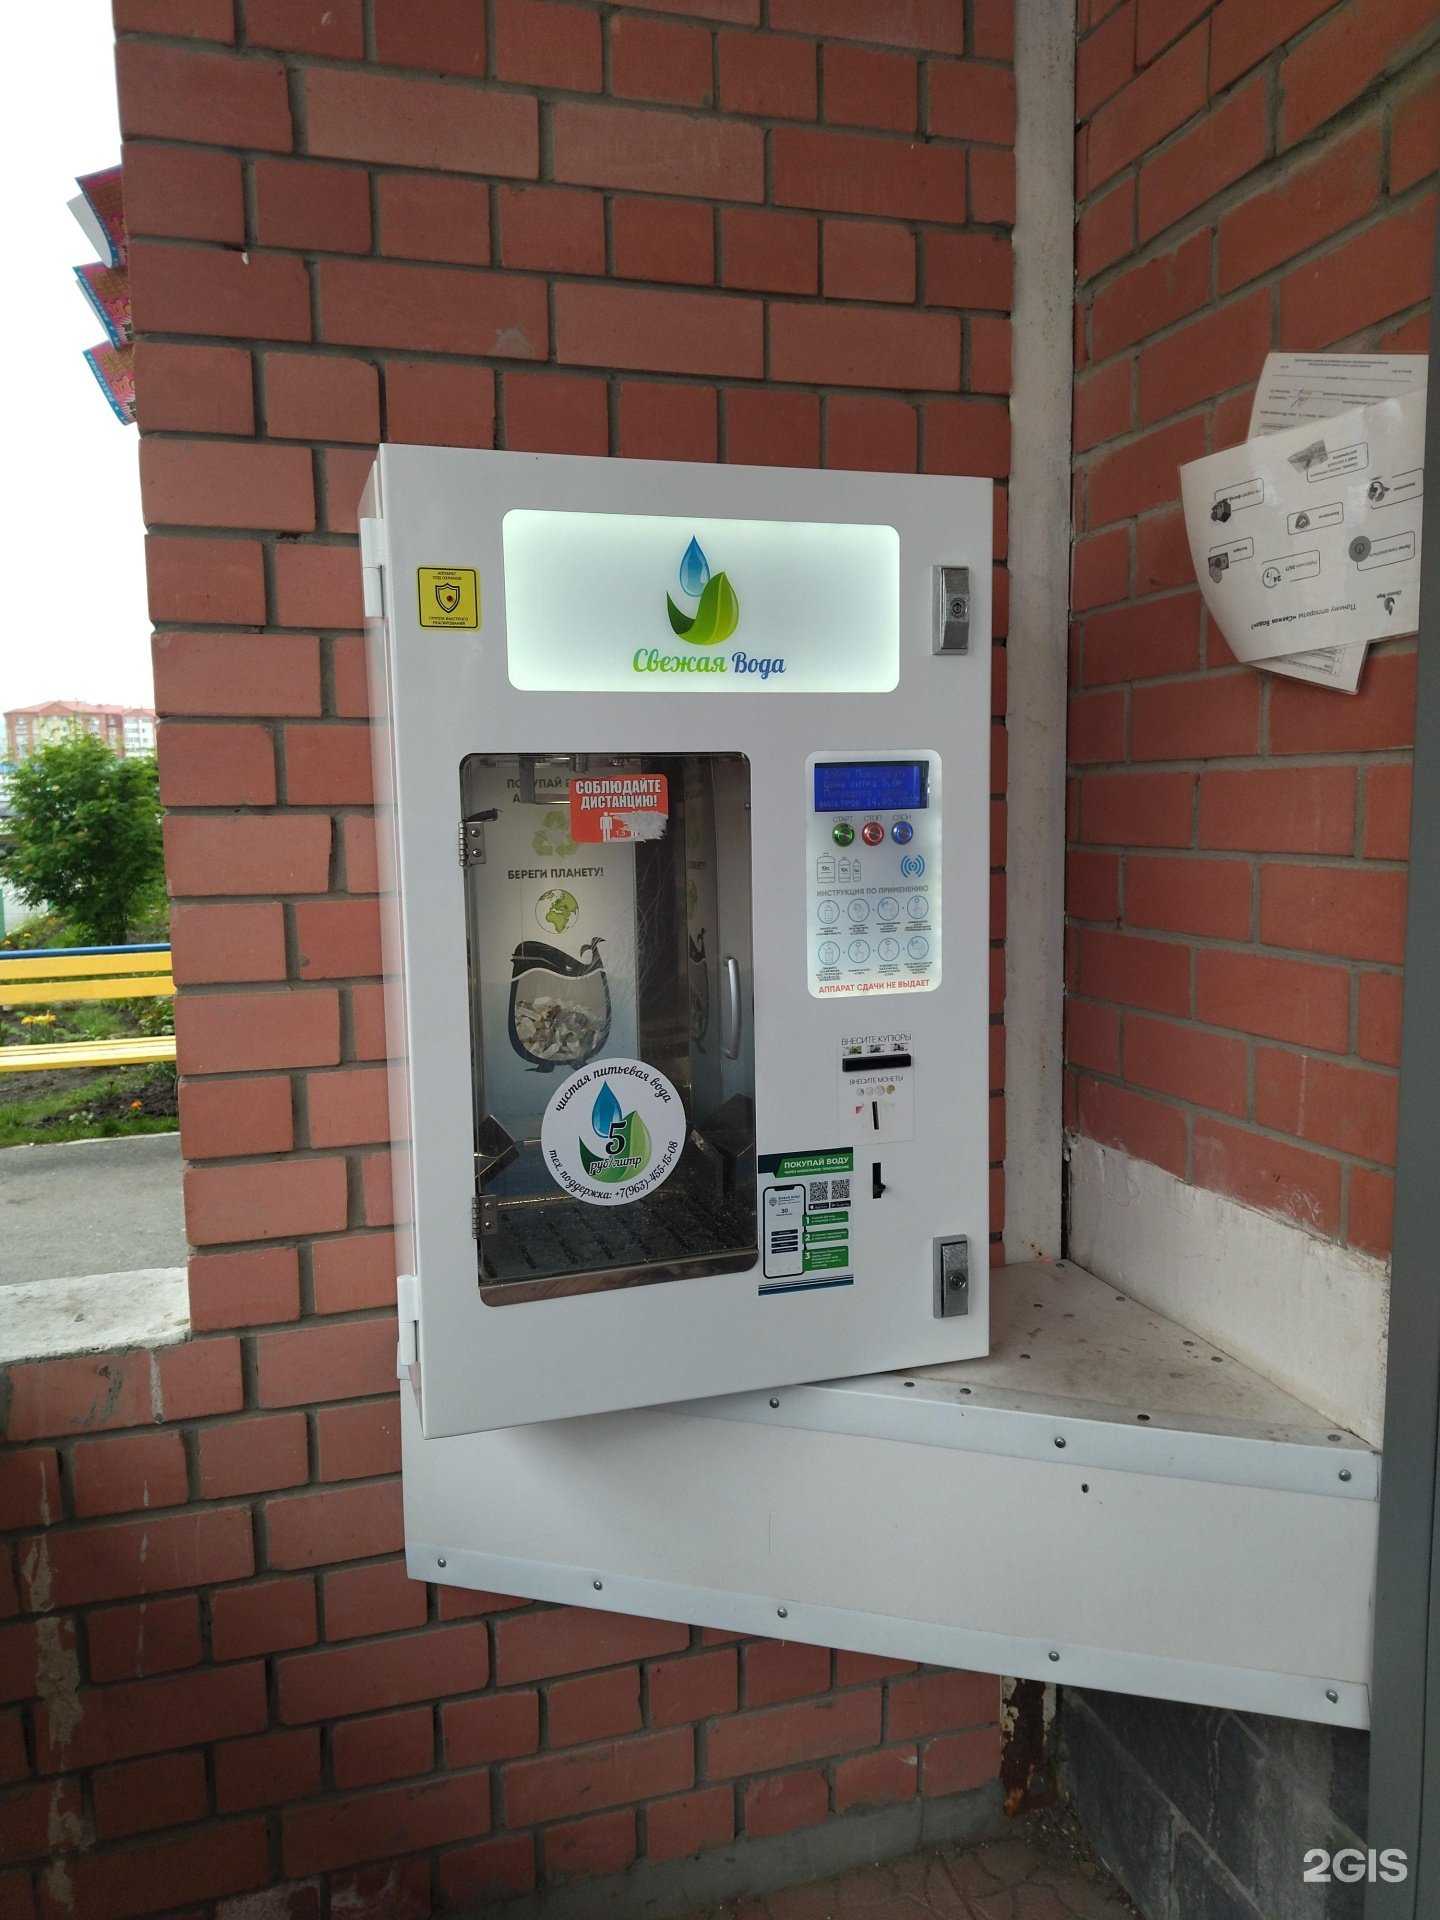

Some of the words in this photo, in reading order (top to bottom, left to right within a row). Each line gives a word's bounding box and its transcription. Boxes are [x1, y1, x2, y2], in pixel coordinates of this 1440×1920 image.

[632, 648, 728, 673] Свежая
[731, 651, 787, 680] Вода
[507, 777, 562, 789] ПОУПАЙ
[575, 778, 661, 796] СОБЛЮДАЙТЕ
[580, 795, 658, 810] ДИСТАНЦИЮ!
[507, 869, 548, 880] БЕРЕГИ
[550, 867, 604, 879] ПЛАНЕТУ!
[816, 888, 865, 897] ИНСТРУКЦИЯ
[866, 887, 877, 895] ПО
[878, 885, 929, 894] ПРИМЕНЕНИЮ
[819, 983, 855, 993] АППАРАТ
[856, 981, 885, 991] СДАЧИ
[886, 980, 897, 988] НЕ
[897, 979, 929, 988] ВЫДАЕТ
[841, 1036, 878, 1046] ВНЕСИТЕ
[878, 1033, 912, 1042] КУПЮРЫ
[849, 1077, 876, 1086] ВНЕСИТЕ
[877, 1075, 904, 1083] МОНЕТЫ
[555, 1074, 592, 1112] чистая
[593, 1066, 650, 1082] питьевая
[650, 1077, 672, 1104] вода
[605, 1120, 627, 1155] 5
[589, 1155, 642, 1176] руб/литр
[784, 1158, 825, 1169] ПОКУПАЙ
[826, 1156, 849, 1166] ВОДУ
[560, 1170, 613, 1200] поддержка:
